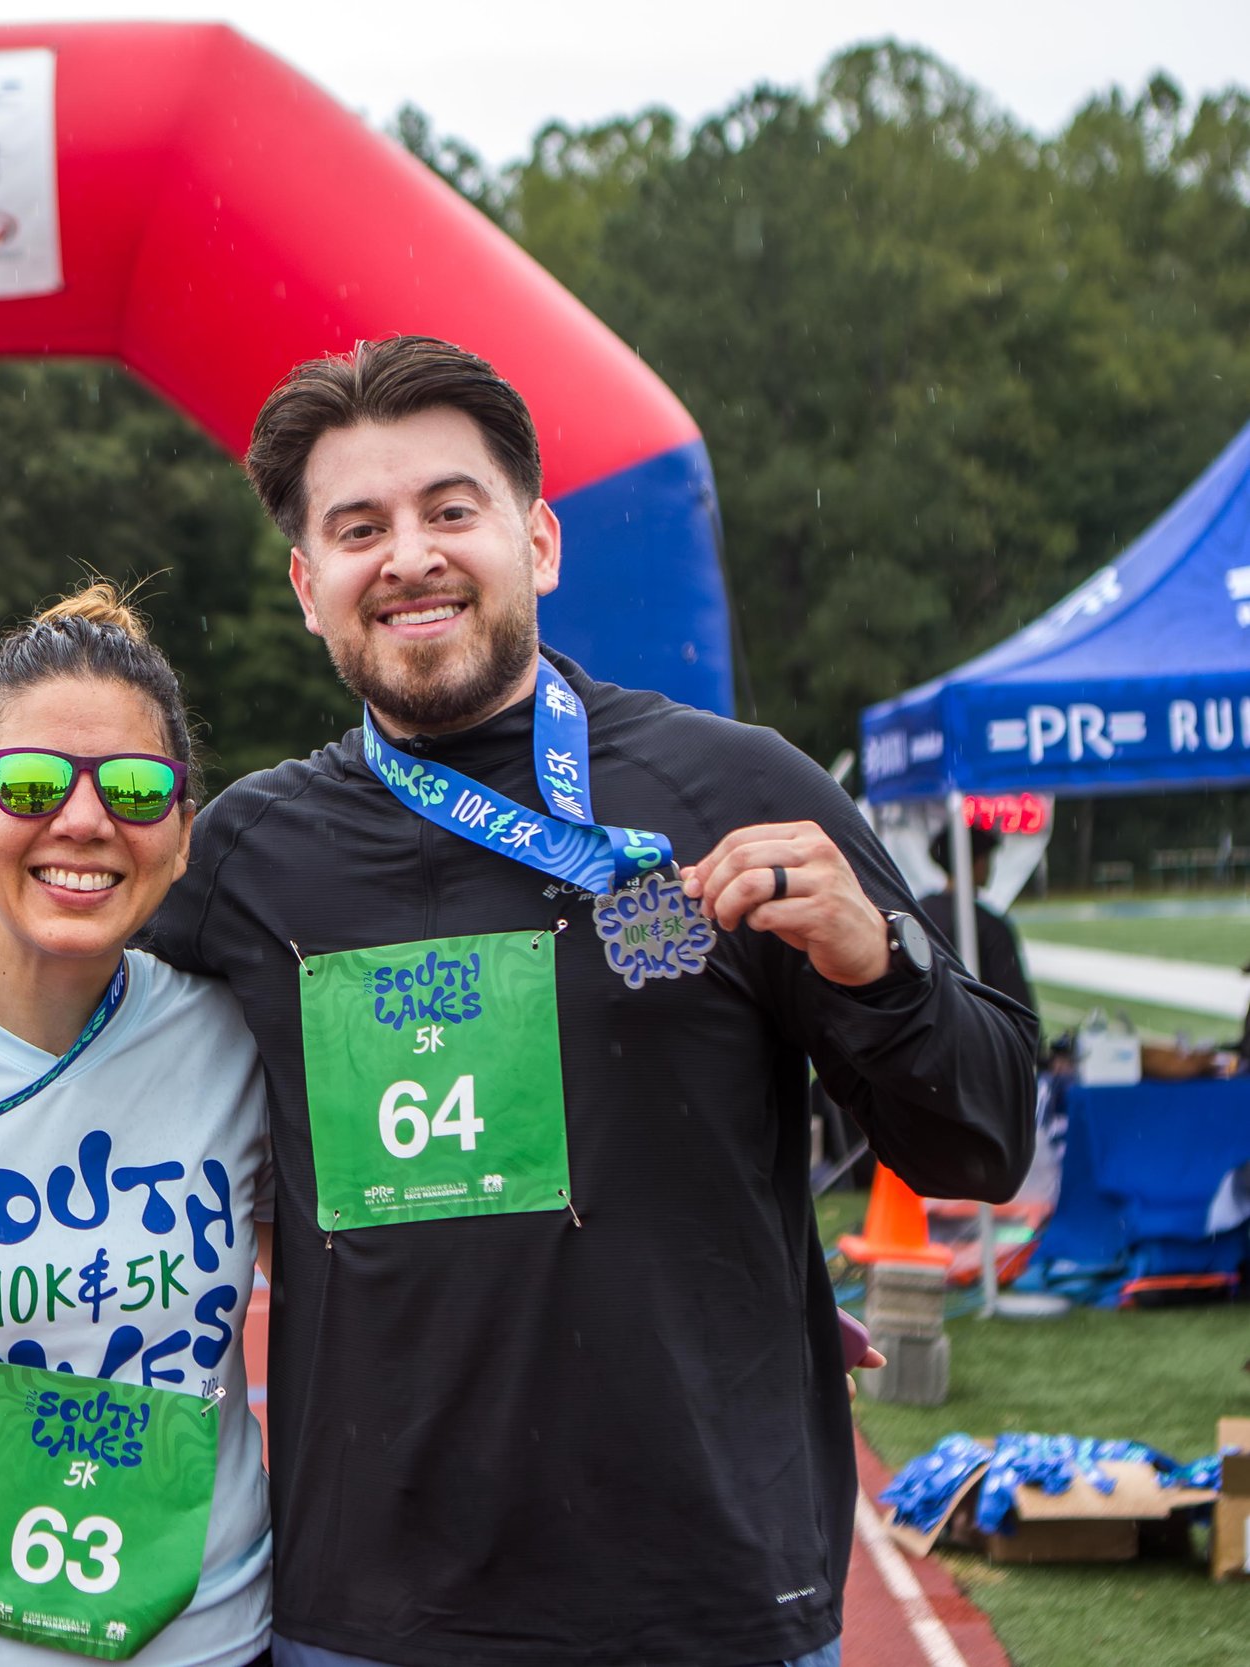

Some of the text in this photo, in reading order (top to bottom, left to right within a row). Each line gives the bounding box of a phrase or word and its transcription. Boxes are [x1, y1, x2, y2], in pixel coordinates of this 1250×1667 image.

[1027, 703, 1117, 765] PR
[376, 742, 449, 808] LAKES
[598, 879, 701, 936] SOUTH
[374, 951, 481, 995] SOUTH
[610, 923, 712, 984] LAKES
[374, 986, 483, 1031] LAKES
[413, 1024, 446, 1055] 5K
[378, 1074, 485, 1159] 64
[37, 1391, 150, 1439] SOUTH
[31, 1418, 143, 1468] LAKES
[64, 1461, 100, 1489] 5K
[11, 1506, 123, 1594] 63
